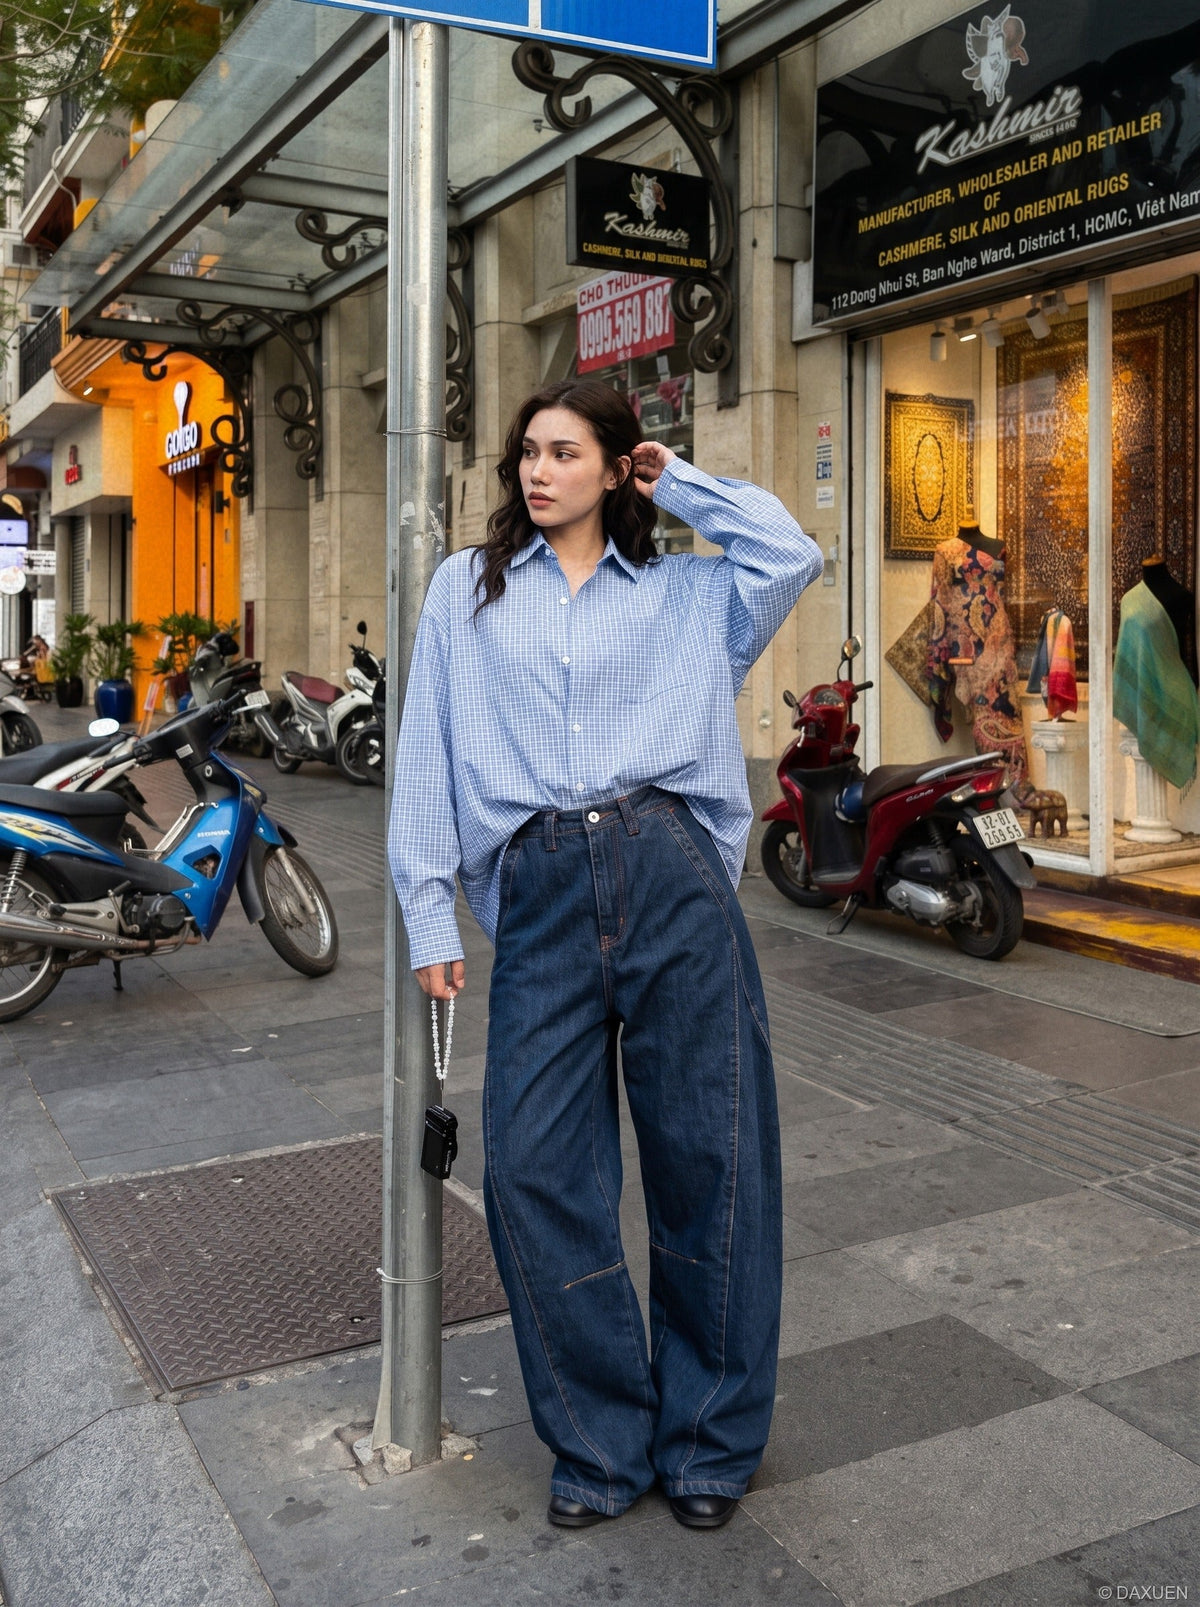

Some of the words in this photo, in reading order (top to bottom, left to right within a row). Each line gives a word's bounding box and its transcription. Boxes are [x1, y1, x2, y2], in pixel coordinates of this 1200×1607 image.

[858, 187, 955, 234] MANUFACTURER,
[958, 152, 1048, 198] WHOLESALER
[1051, 140, 1083, 166] AND
[1087, 111, 1162, 153] RETAILER
[914, 86, 1081, 174] Kashmir
[604, 211, 690, 243] Kashmir
[878, 232, 946, 267] CASHMERE,
[949, 221, 979, 245] SILK
[981, 211, 1010, 235] AND
[1014, 188, 1083, 224] ORIENTAL
[1087, 172, 1130, 201] RUGS
[983, 191, 1001, 211] OF
[625, 248, 641, 260] SILK
[641, 251, 657, 262] AND
[831, 293, 848, 310] 112
[850, 286, 877, 303] Dong
[904, 271, 920, 288] St,
[922, 266, 945, 283] Ban
[947, 256, 977, 278] Nghe
[980, 242, 1015, 266] Ward,
[1018, 227, 1065, 255] District
[1068, 223, 1081, 241] 1,
[1085, 208, 1132, 236] HCMC,
